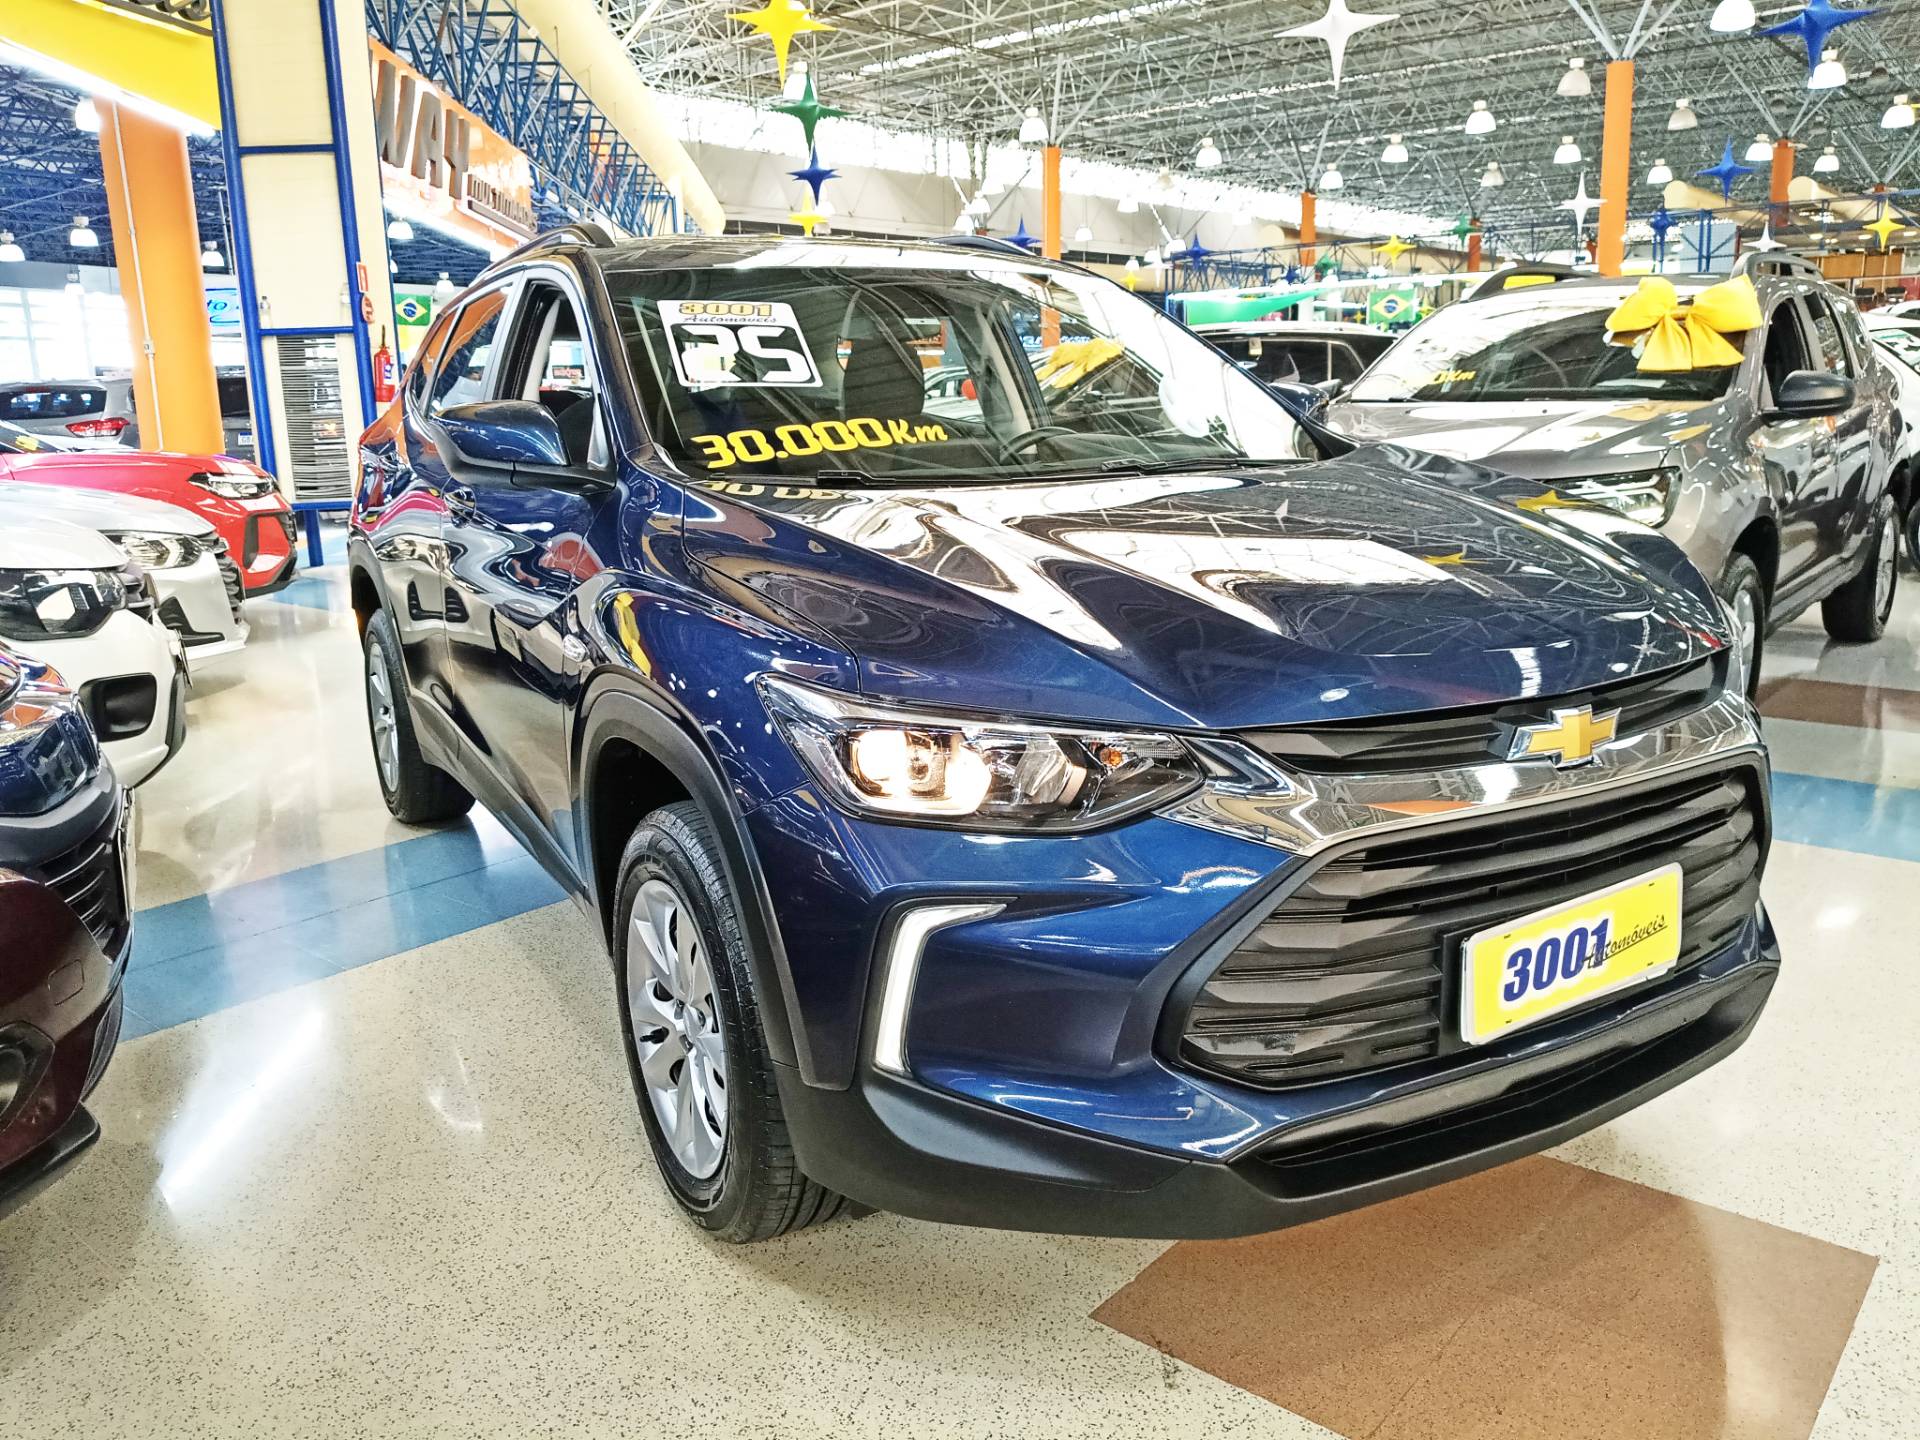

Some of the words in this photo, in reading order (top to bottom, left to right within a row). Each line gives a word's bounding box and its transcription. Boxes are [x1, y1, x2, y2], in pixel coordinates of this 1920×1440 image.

[679, 302, 773, 317] 3001
[681, 325, 812, 383] 25
[1503, 918, 1610, 1003] 3001
